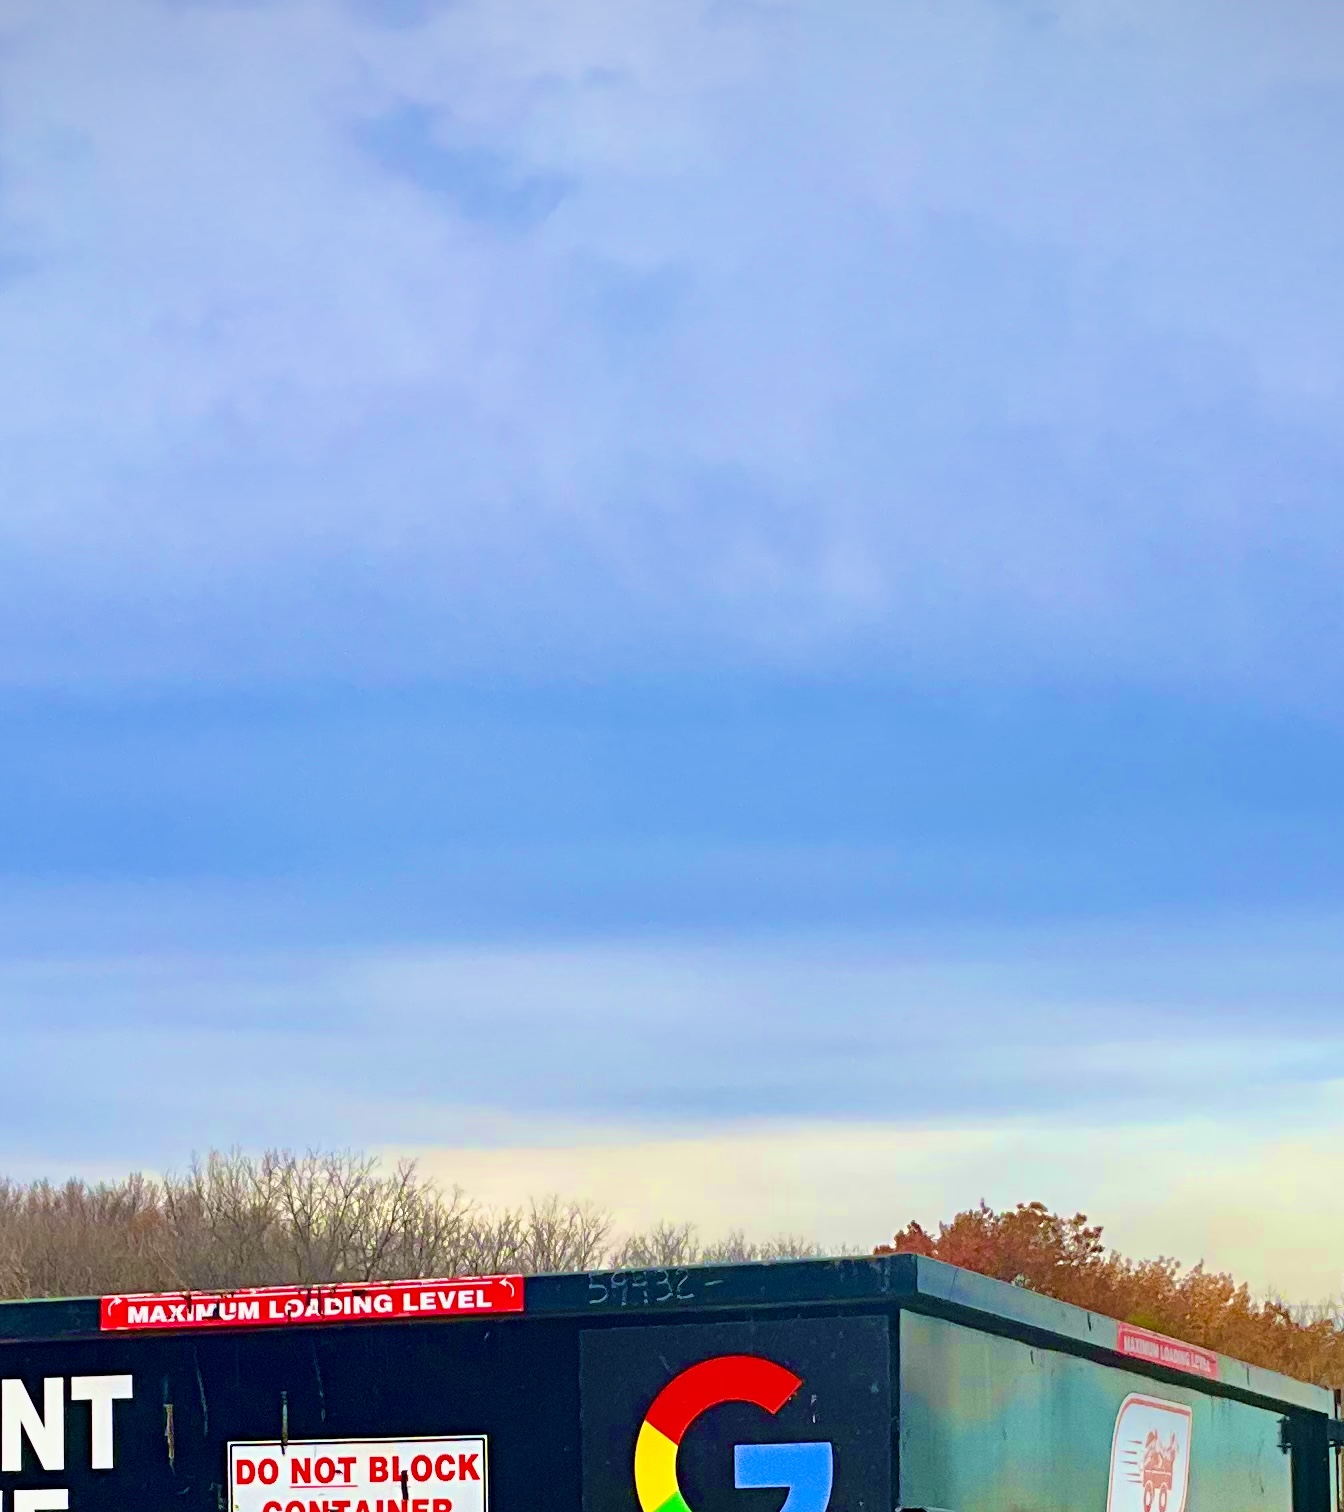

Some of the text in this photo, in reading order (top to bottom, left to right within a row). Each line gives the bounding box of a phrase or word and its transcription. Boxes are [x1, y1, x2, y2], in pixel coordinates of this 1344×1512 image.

[127, 1289, 493, 1324] MAXIMUM LOADING LEVEL
[235, 1453, 481, 1485] DO NOT BLOCK
